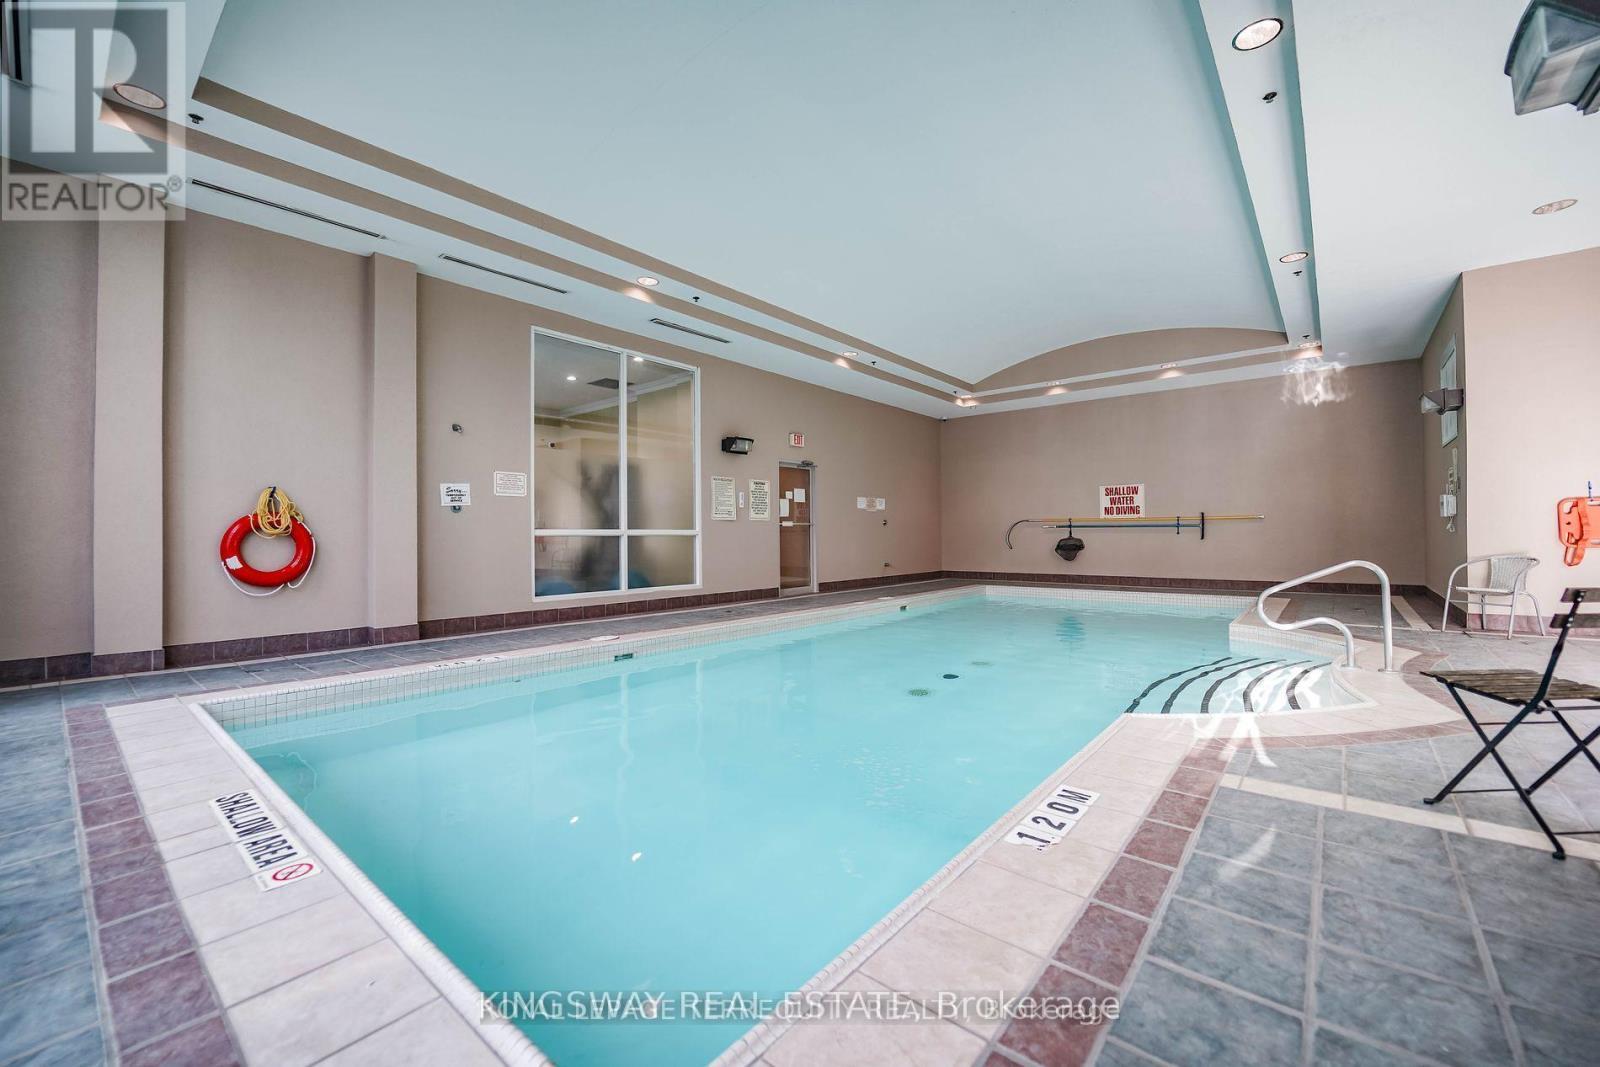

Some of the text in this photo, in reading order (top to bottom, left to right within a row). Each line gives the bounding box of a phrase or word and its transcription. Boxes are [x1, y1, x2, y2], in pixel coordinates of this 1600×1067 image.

[1104, 486, 1139, 497] SHALLOW
[1110, 496, 1135, 506] WATER
[1104, 505, 1140, 516] NO DIVING
[215, 792, 298, 869] SHALLOW AREA
